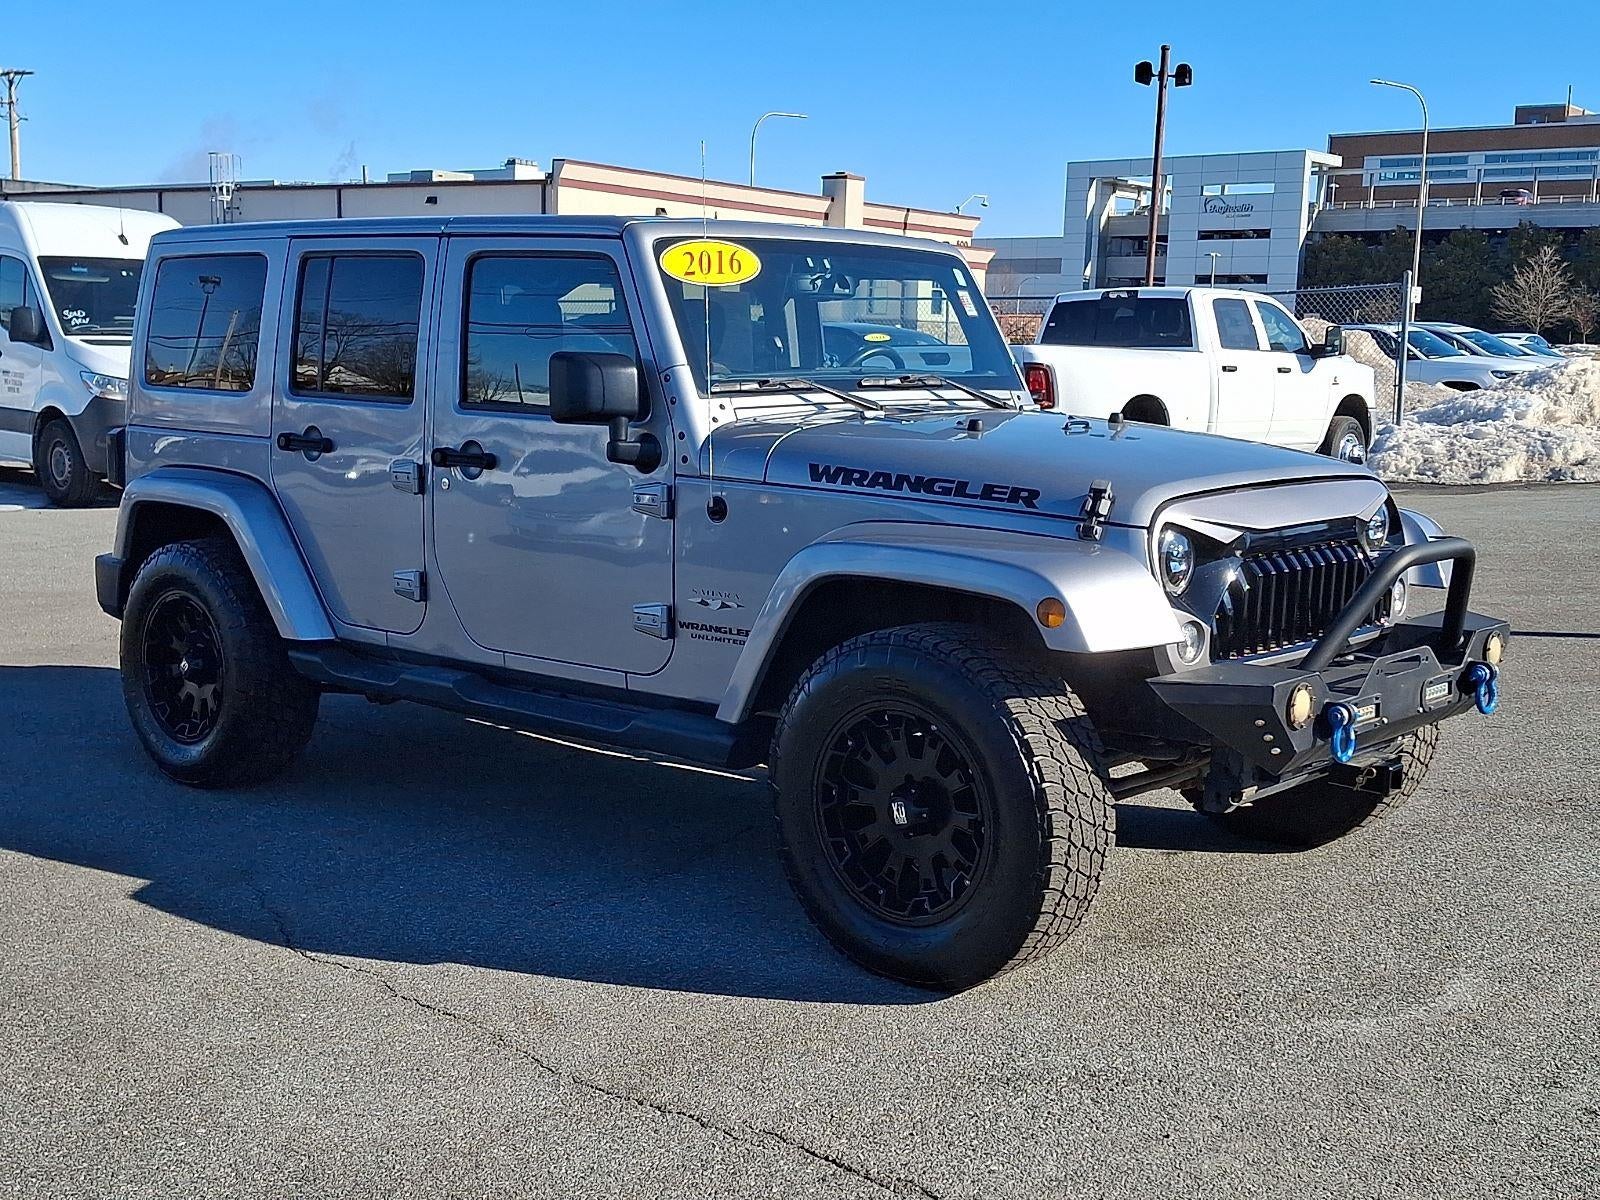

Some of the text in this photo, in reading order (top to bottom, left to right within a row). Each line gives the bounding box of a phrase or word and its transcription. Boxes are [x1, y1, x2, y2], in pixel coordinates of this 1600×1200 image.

[682, 249, 741, 276] 2016
[808, 463, 1041, 509] WRANGLER
[692, 588, 742, 600] SAHARA
[690, 632, 746, 646] UNLIMITED
